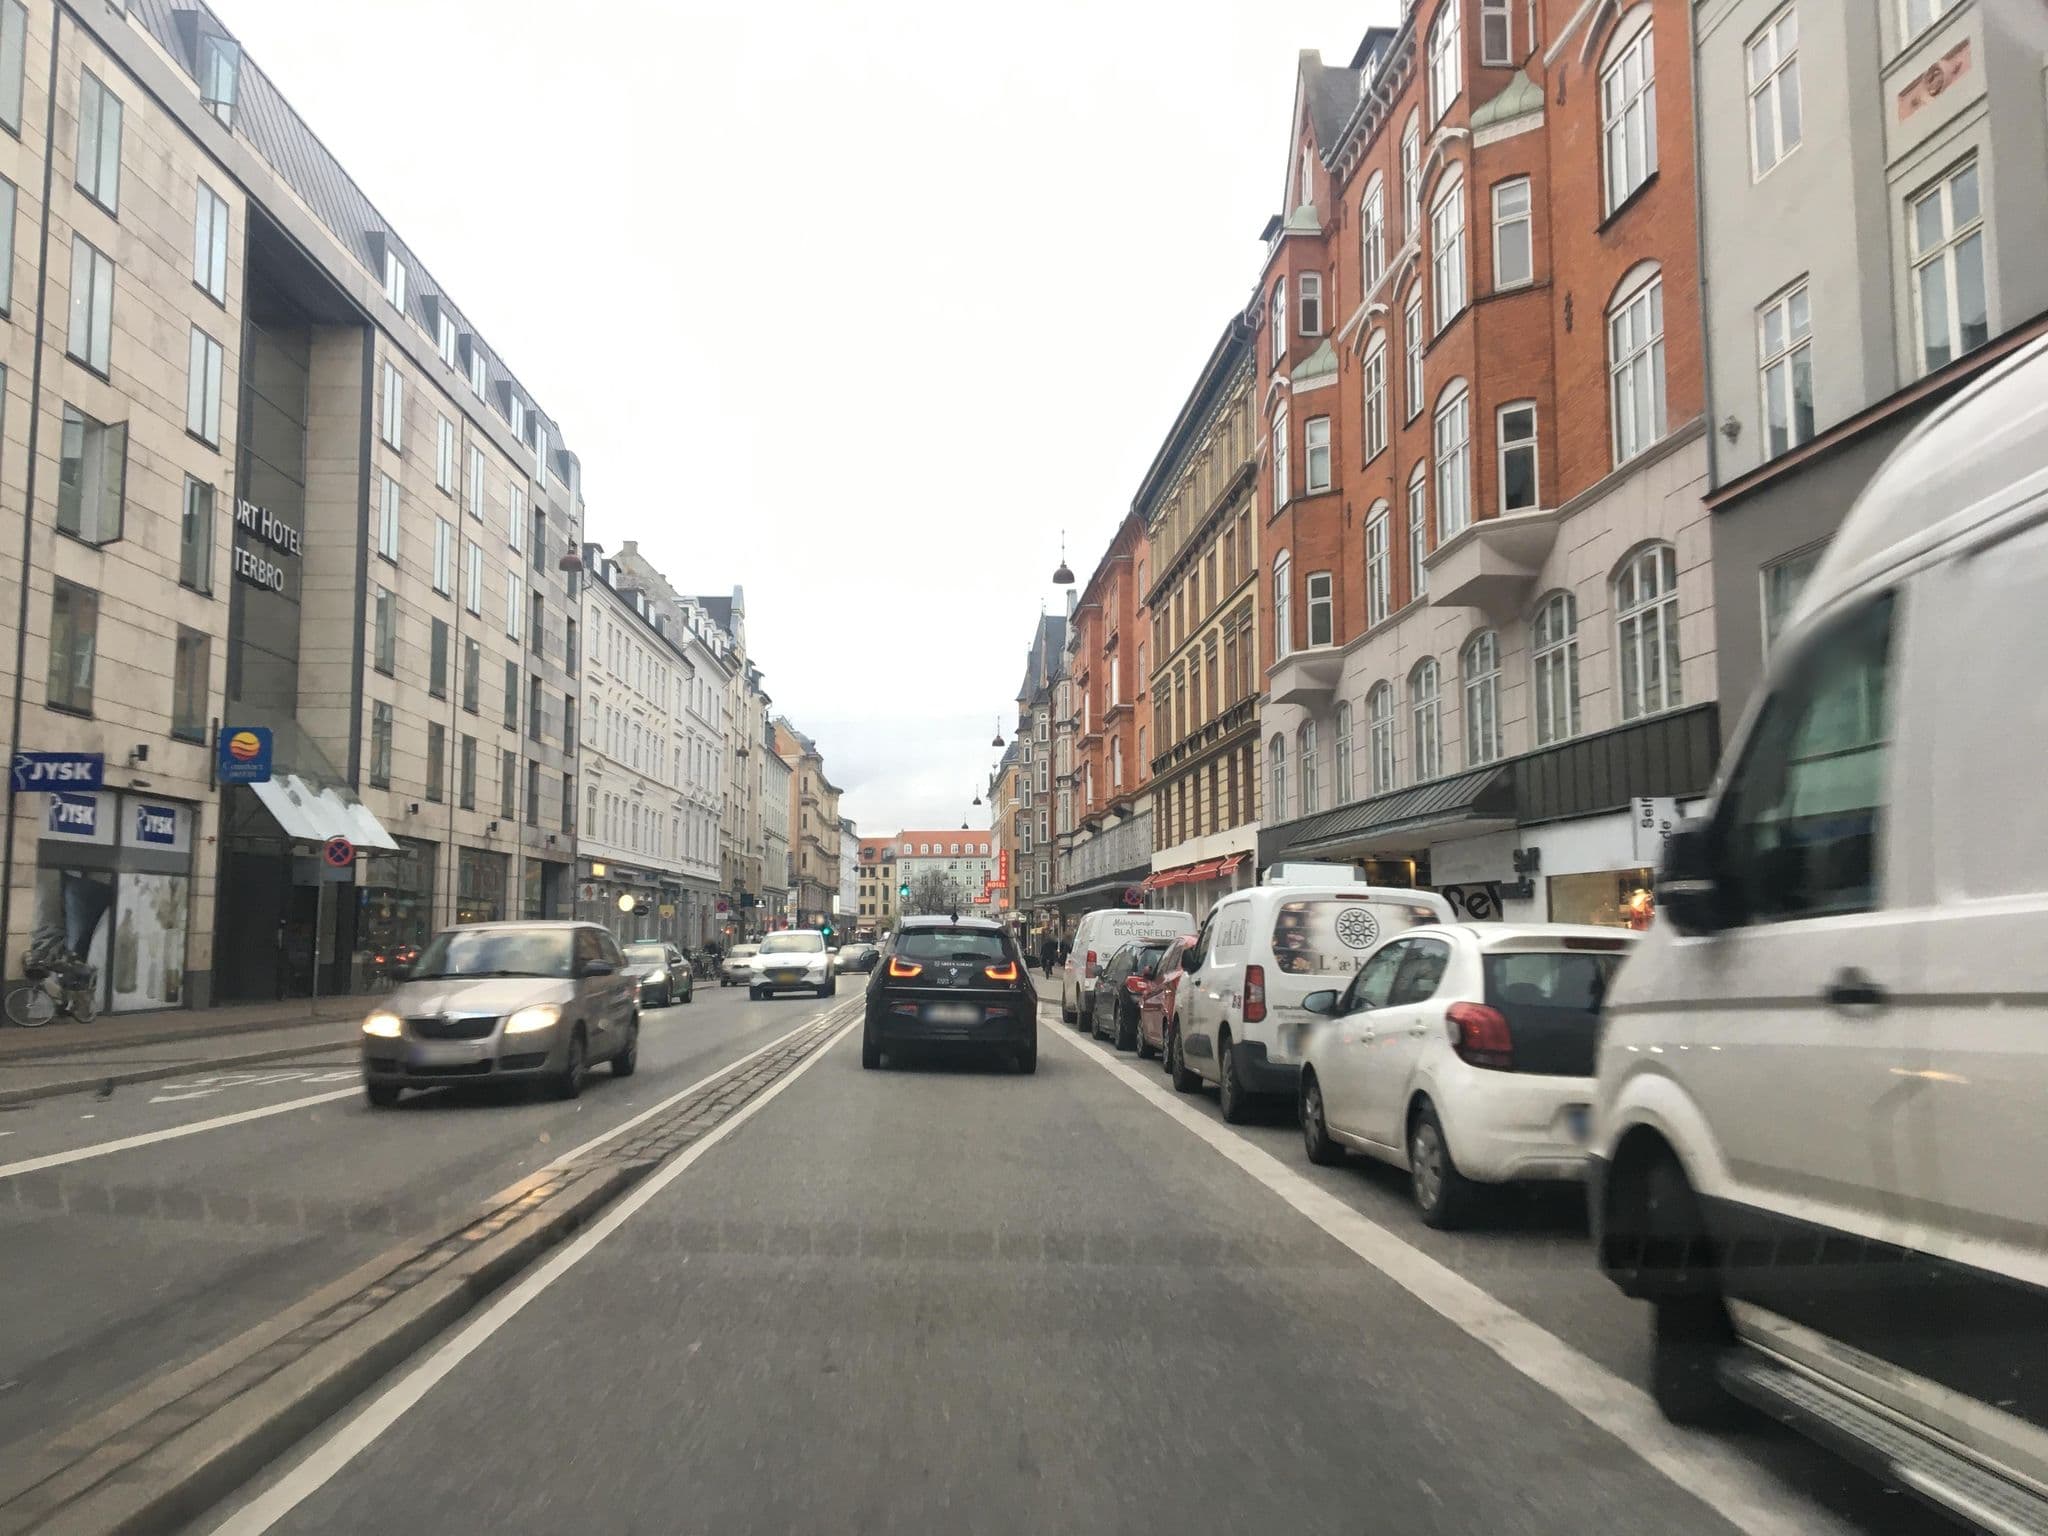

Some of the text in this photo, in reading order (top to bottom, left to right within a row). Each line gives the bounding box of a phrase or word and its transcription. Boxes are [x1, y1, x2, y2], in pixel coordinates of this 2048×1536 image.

[261, 507, 302, 557] HOTEL
[234, 546, 284, 592] TERBRO
[29, 762, 94, 781] JYSK
[58, 803, 95, 826] JYSK
[144, 814, 174, 834] JYSK
[1641, 797, 1654, 829] Self
[1113, 928, 1177, 938] BLAUENFELDT
